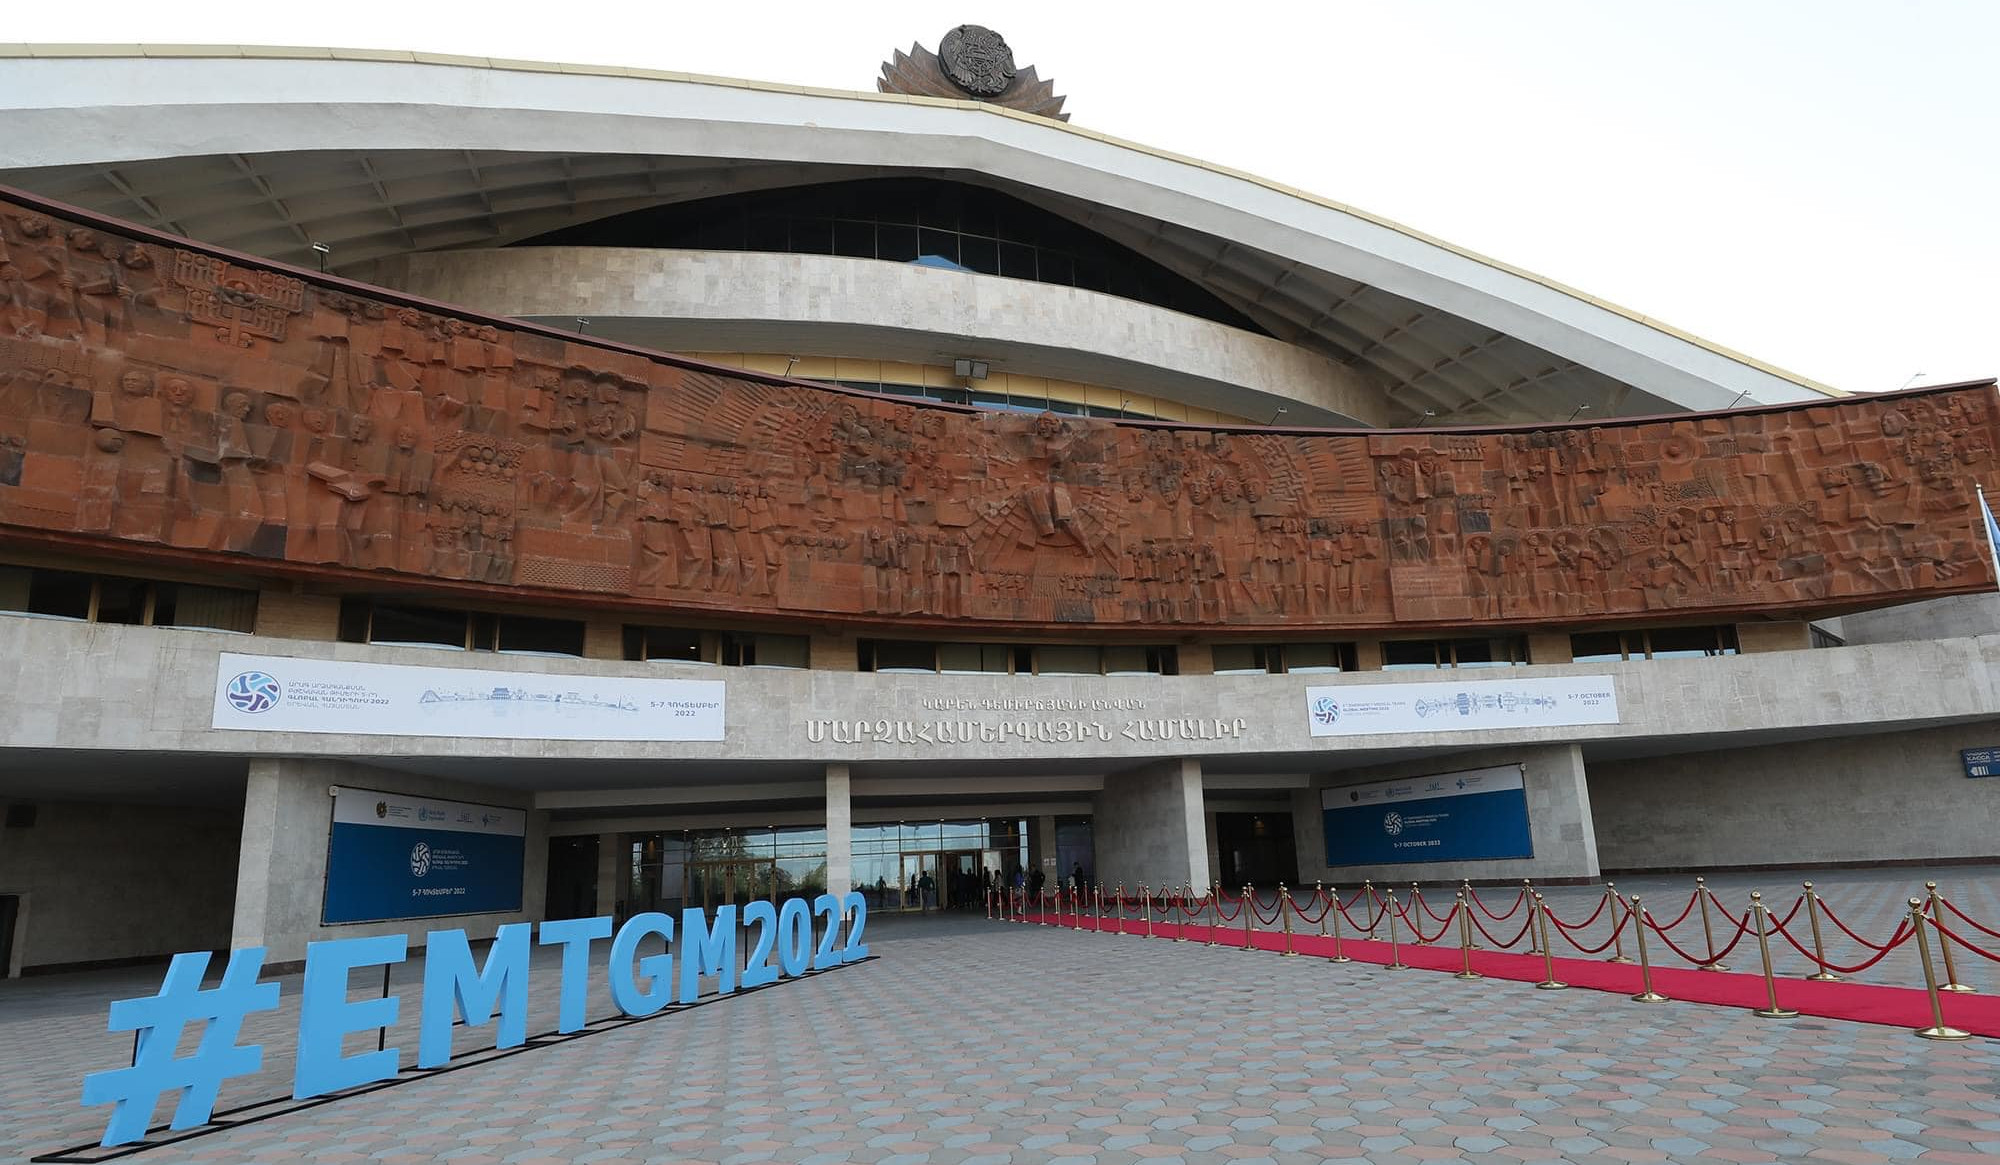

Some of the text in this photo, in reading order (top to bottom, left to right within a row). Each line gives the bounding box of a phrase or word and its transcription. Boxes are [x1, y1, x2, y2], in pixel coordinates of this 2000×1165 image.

[922, 697, 1146, 711] ԿԱՐԵՆ ԴԵՄԻՐՃՅԱՆԻ ԱՆՎԱՆ
[807, 716, 1247, 745] ՄԱՐԶԱՀԱՄԵՐԳԱՅԻՆ ՀԱՄԱԼԻՐ
[80, 891, 869, 1148] #EMTGM2022
